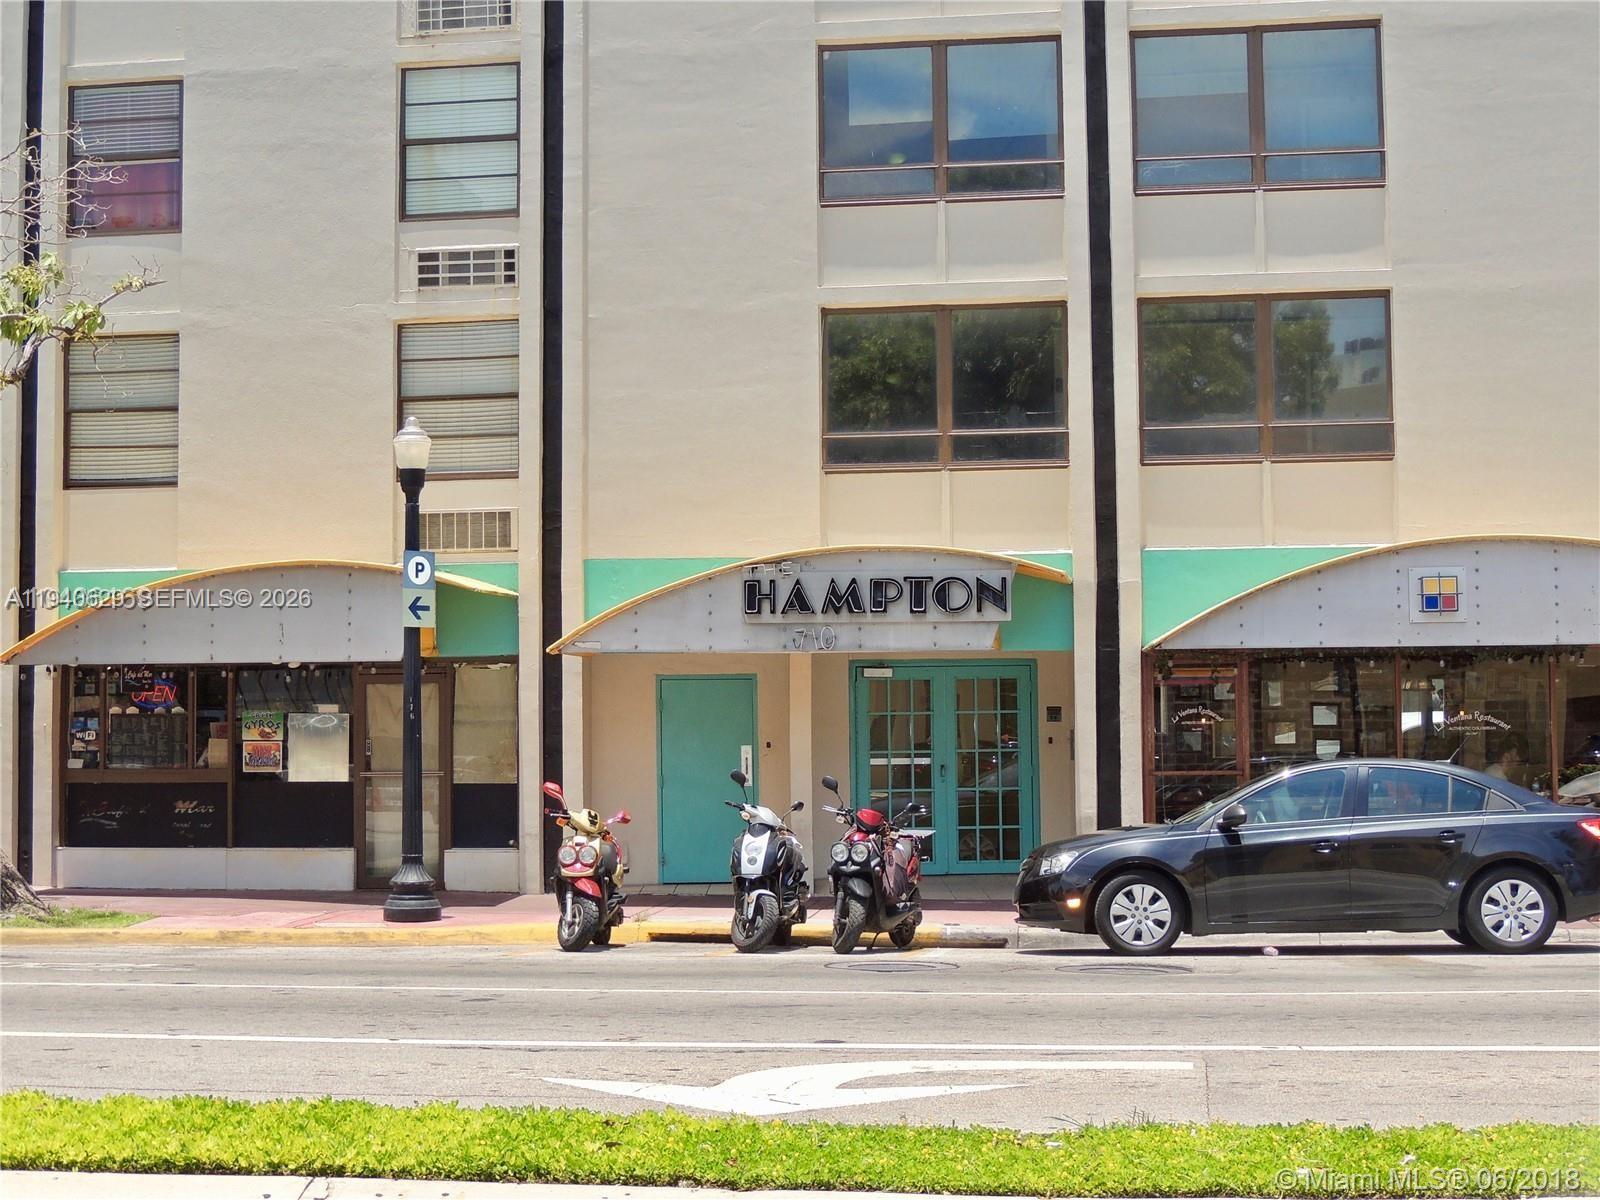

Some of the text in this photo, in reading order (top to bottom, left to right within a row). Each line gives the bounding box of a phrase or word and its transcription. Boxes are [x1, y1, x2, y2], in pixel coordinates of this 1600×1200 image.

[415, 562, 425, 578] P
[742, 561, 793, 577] THE
[744, 577, 1008, 615] HAMPTON
[244, 719, 281, 730] GYROS
[1474, 711, 1512, 731] Restaurant
